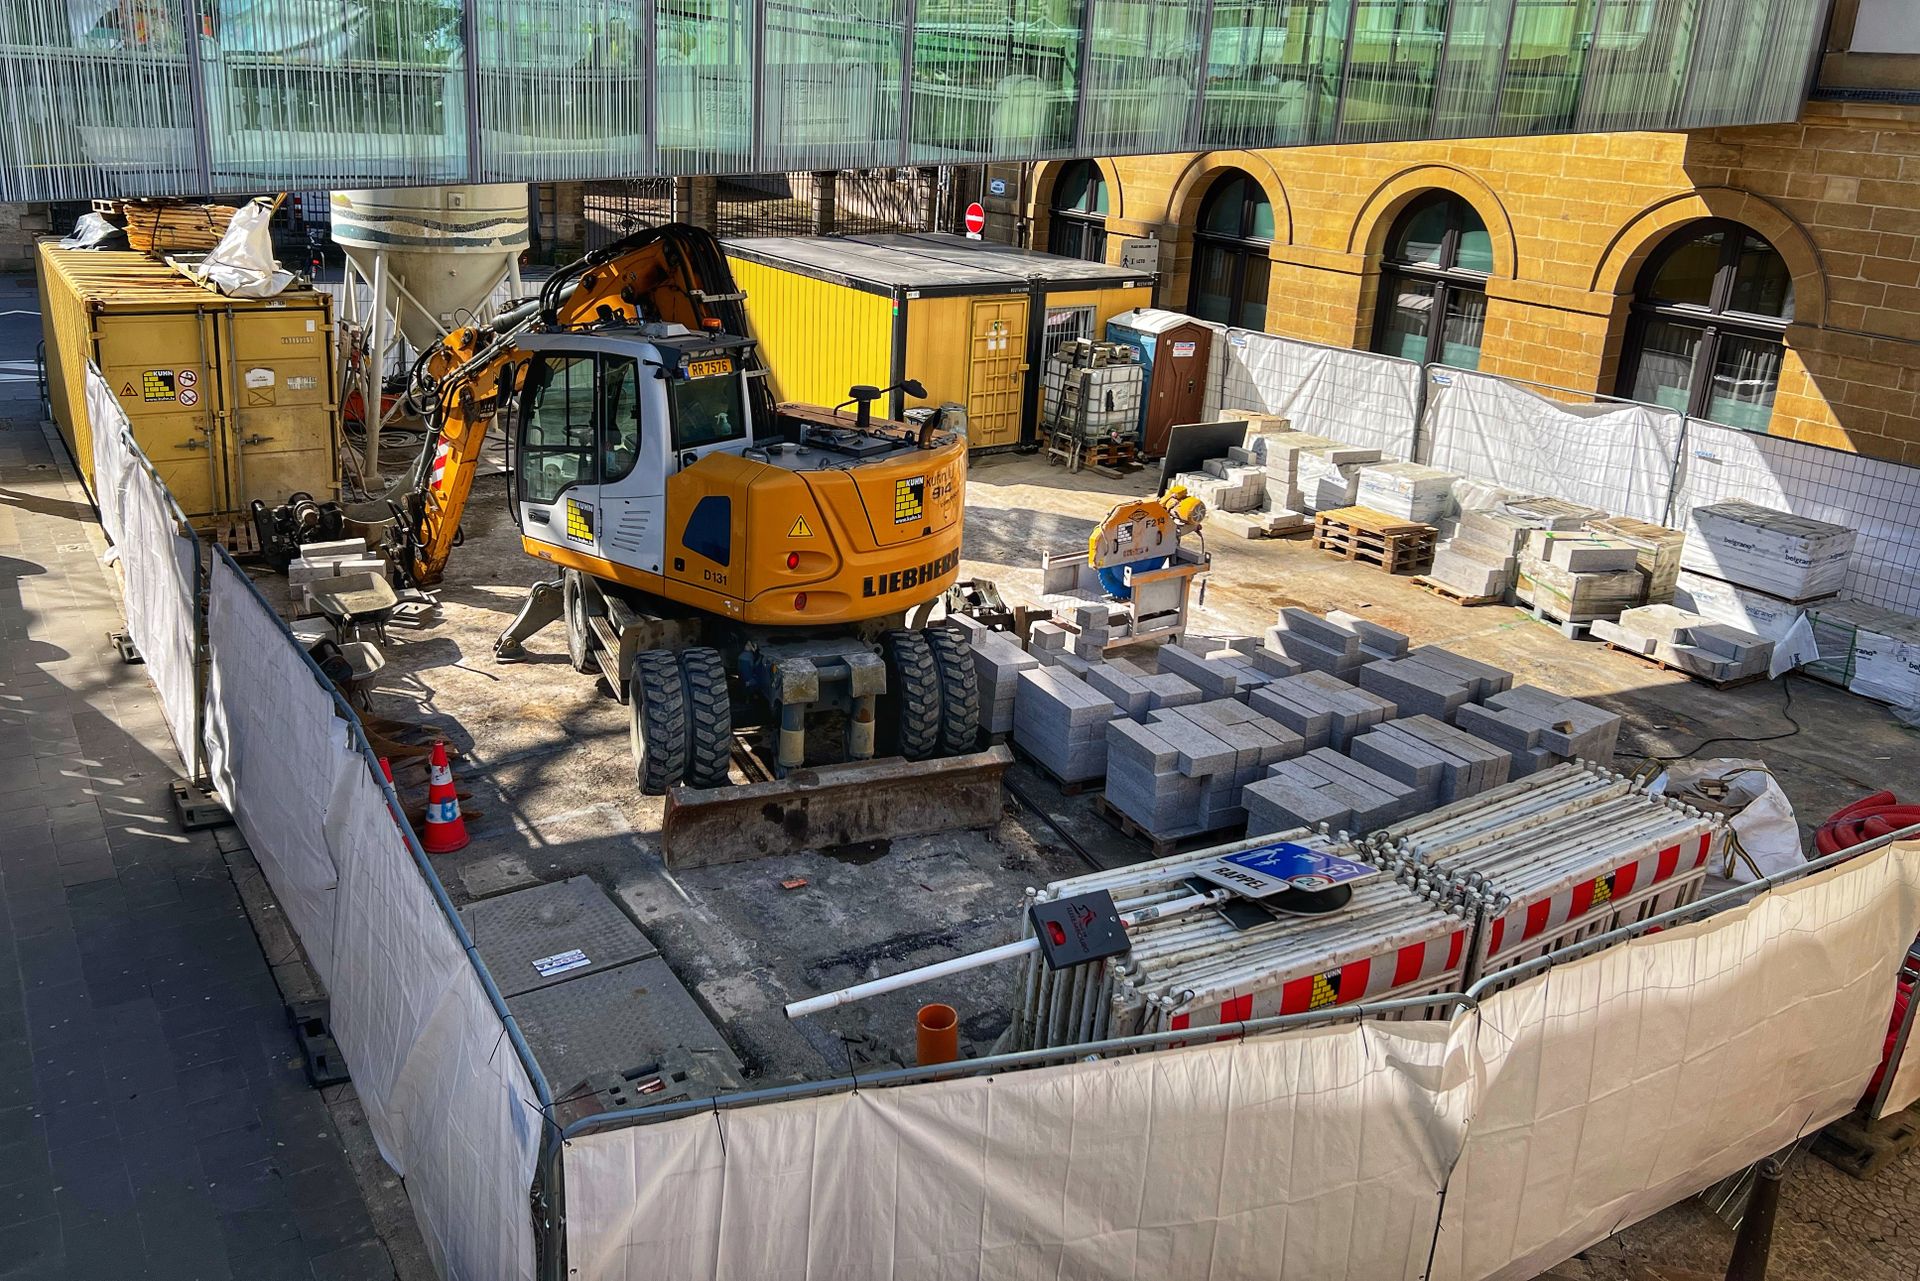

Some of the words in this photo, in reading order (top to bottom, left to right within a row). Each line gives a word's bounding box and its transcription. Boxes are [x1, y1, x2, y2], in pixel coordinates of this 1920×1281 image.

[905, 477, 924, 487] KUHN
[1145, 517, 1166, 529] F214
[704, 569, 727, 586] D131
[863, 547, 960, 598] LIEBHERR
[1211, 866, 1269, 891] RAPPEL
[1297, 877, 1324, 888] 20
